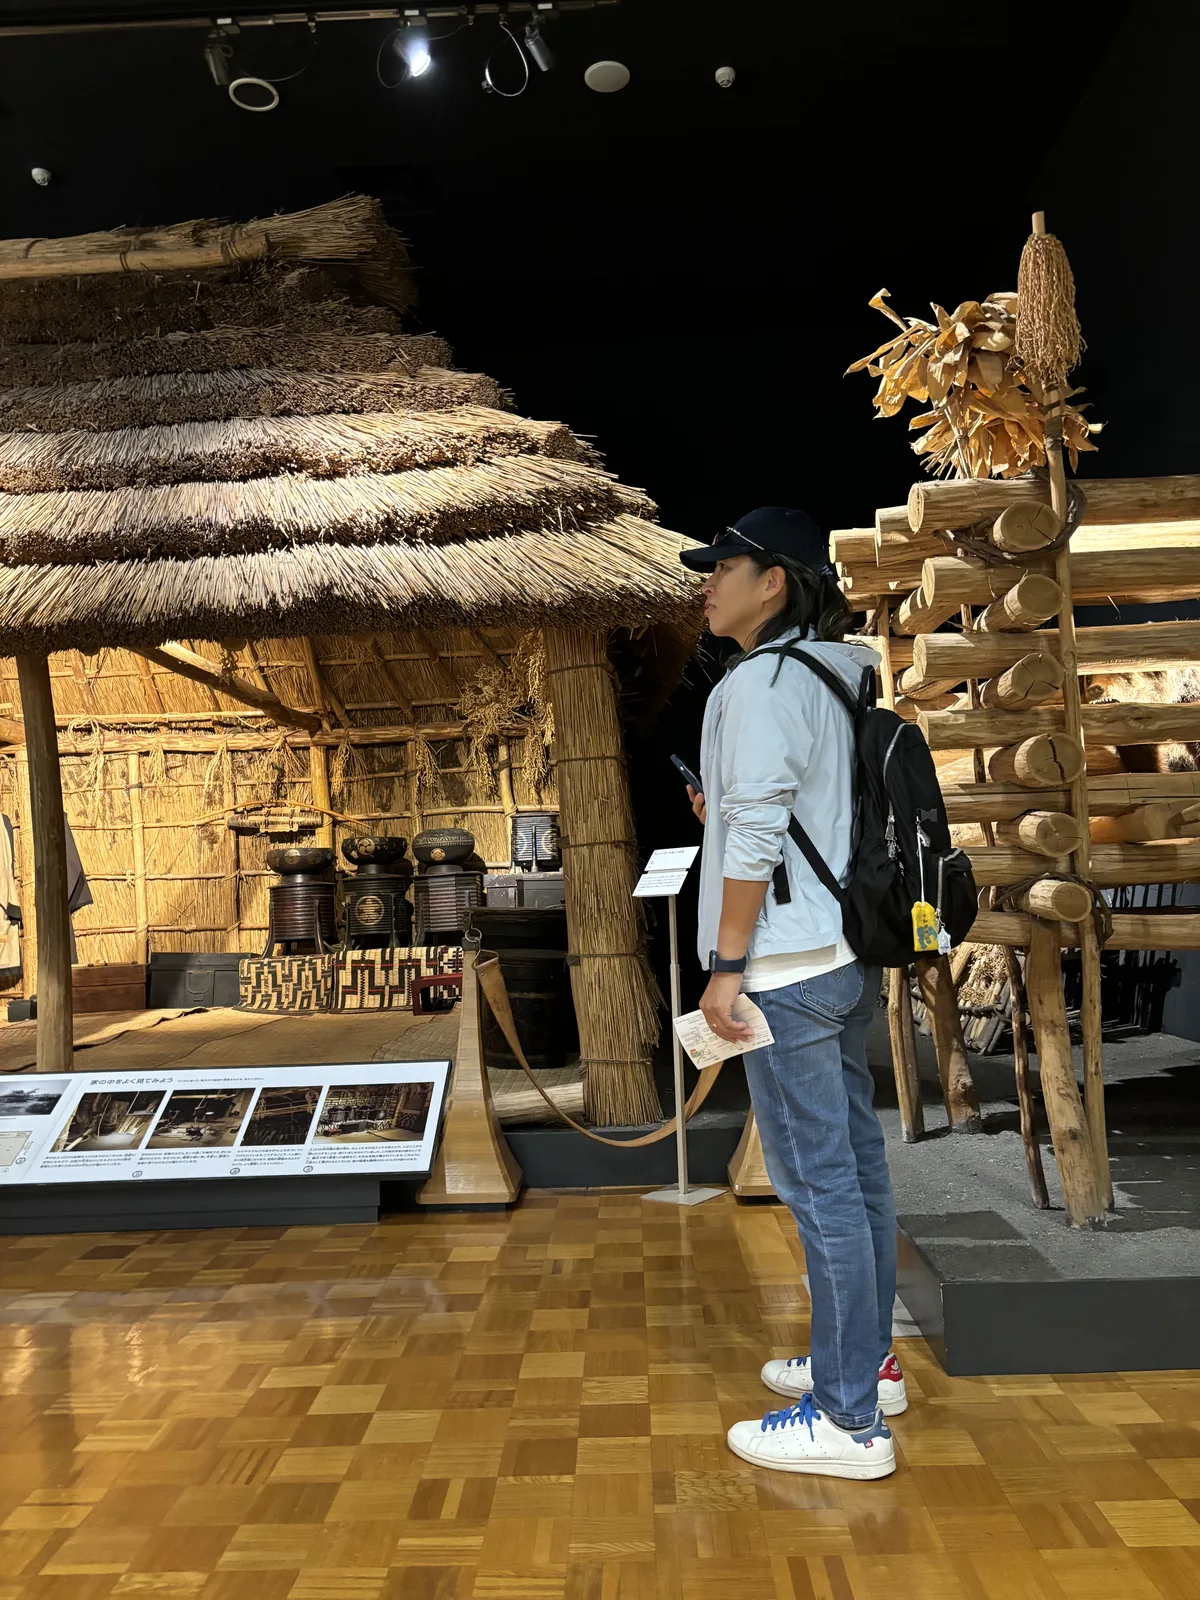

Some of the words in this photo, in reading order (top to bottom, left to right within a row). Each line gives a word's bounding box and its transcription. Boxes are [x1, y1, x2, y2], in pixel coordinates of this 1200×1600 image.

[90, 1077, 174, 1086] 家の中をよく見てみよう
